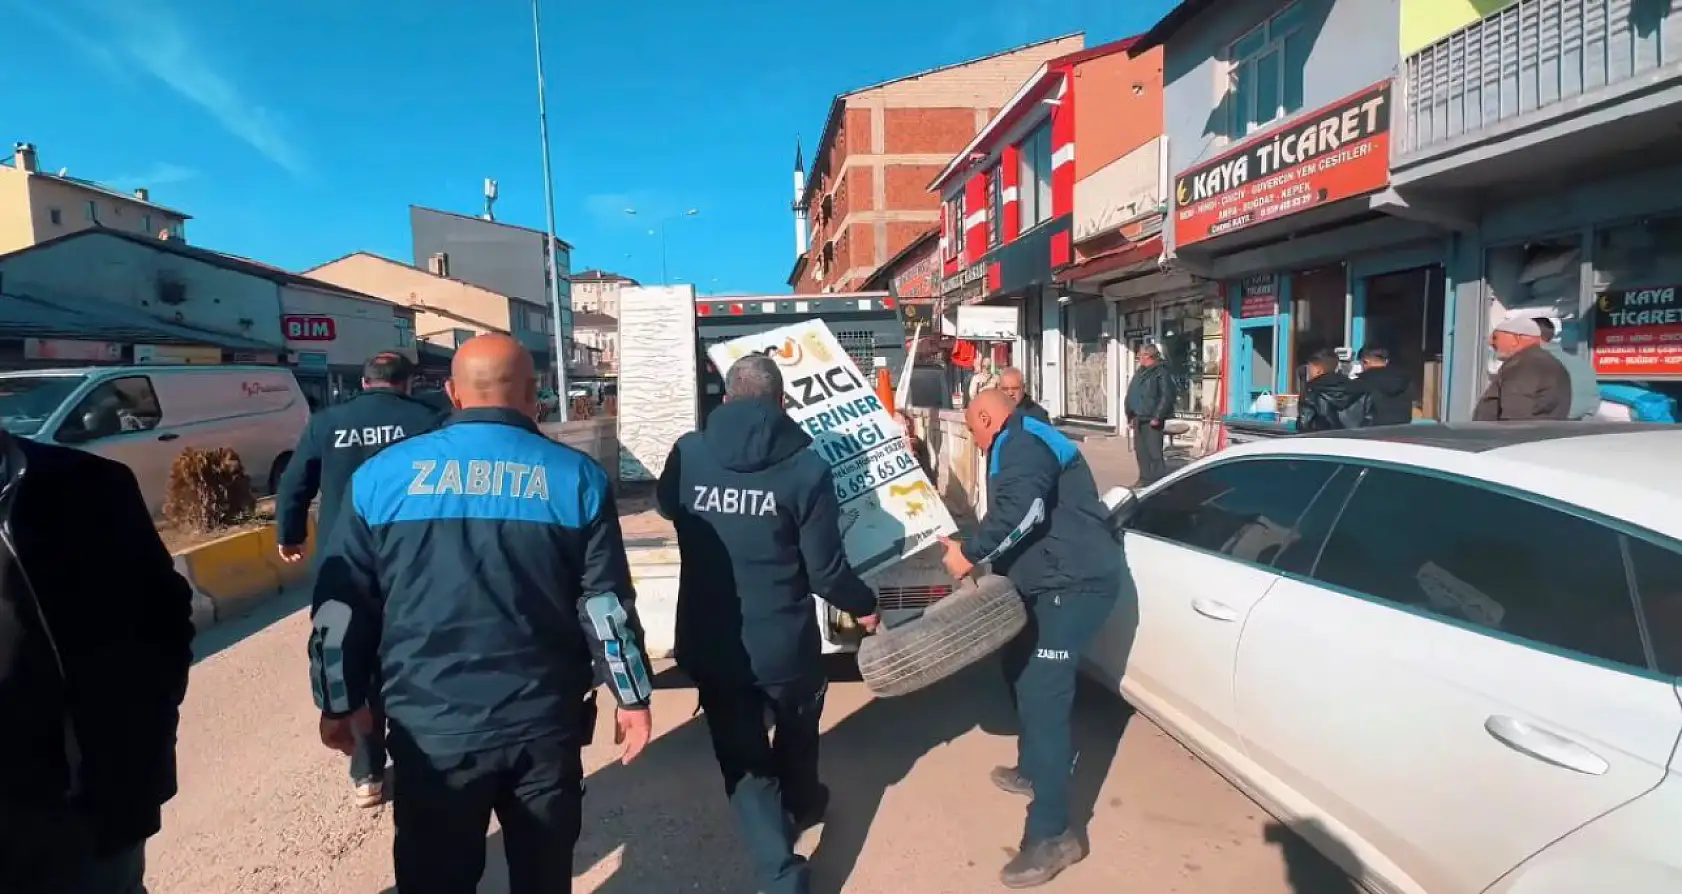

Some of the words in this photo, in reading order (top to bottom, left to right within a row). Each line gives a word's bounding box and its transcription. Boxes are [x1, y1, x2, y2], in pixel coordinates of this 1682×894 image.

[1193, 155, 1249, 201] KAYA
[1257, 96, 1385, 174] TİCARET
[1625, 288, 1675, 305] KAYA
[288, 318, 329, 337] BİM
[782, 365, 863, 410] AZICI
[800, 395, 883, 436] ERİNER
[334, 425, 405, 448] ZABITA
[821, 418, 885, 463] İNİĞİ
[408, 460, 549, 500] ZABITA
[848, 471, 876, 493] 695
[877, 460, 896, 479] 65
[896, 452, 914, 470] 04
[694, 485, 778, 516] ZABITA
[1037, 648, 1069, 661] ZABITA
